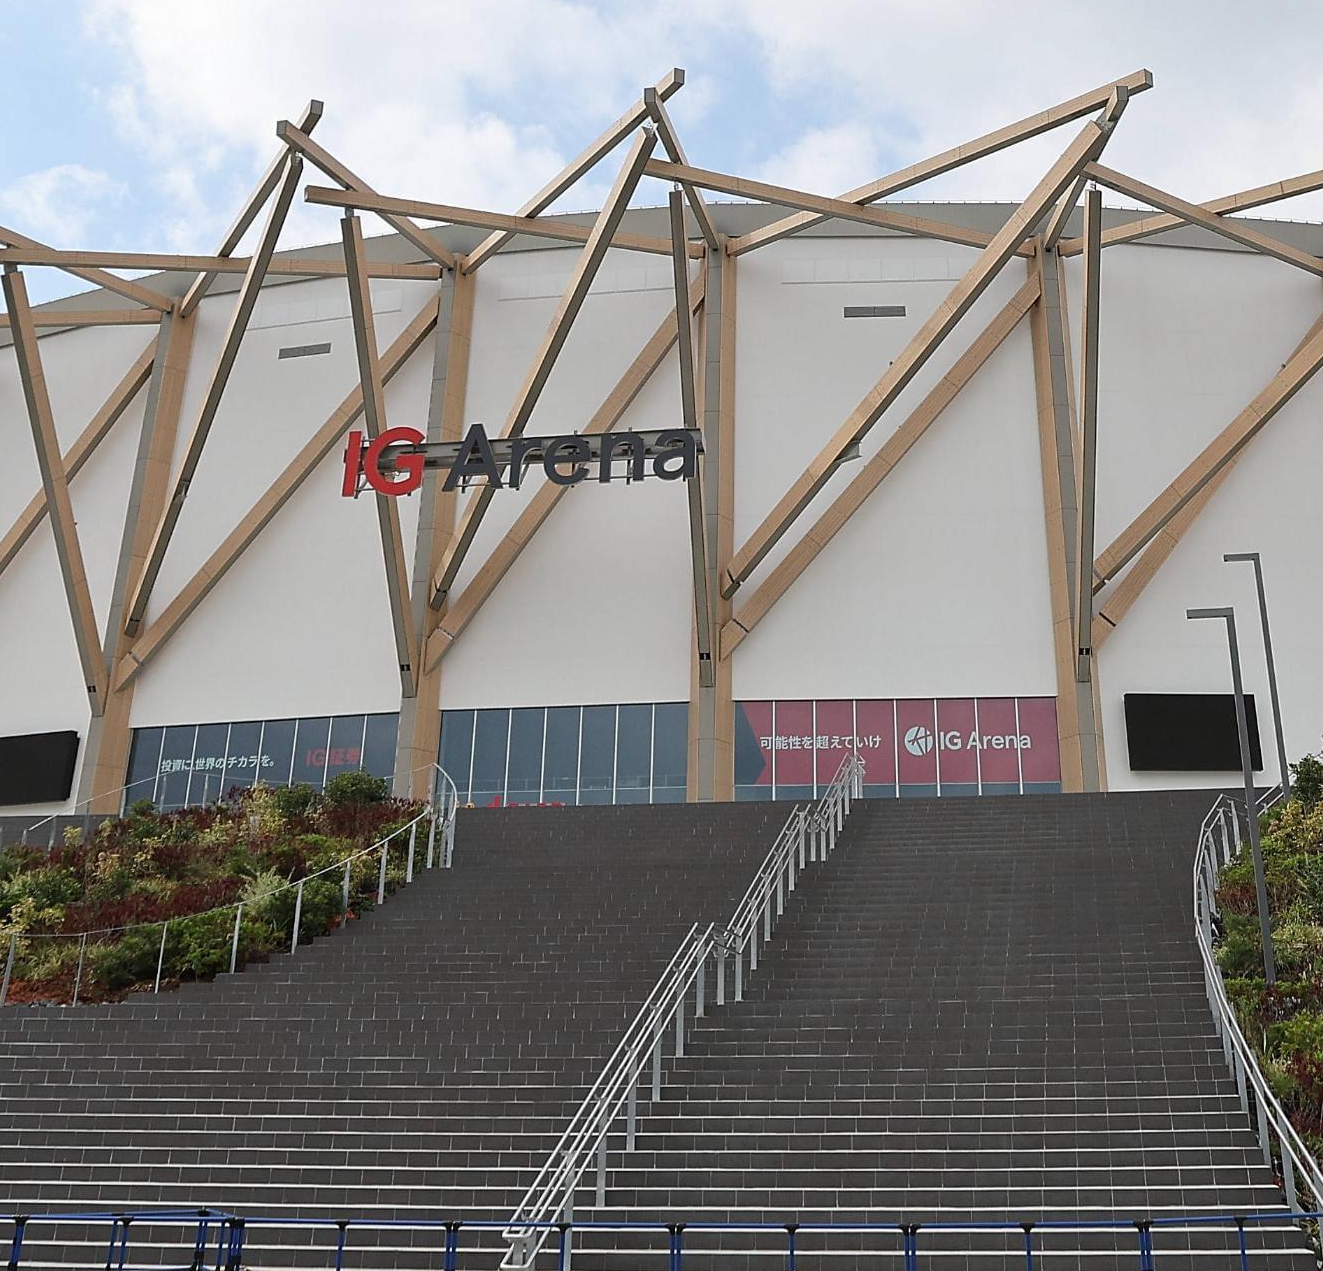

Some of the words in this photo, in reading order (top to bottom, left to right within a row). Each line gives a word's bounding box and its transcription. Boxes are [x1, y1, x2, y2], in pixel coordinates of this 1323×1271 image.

[341, 426, 426, 497] IG
[442, 423, 697, 492] Arena
[759, 735, 882, 751] 可能性を超えていけ
[940, 731, 963, 750] IG
[966, 730, 1032, 750] Arena
